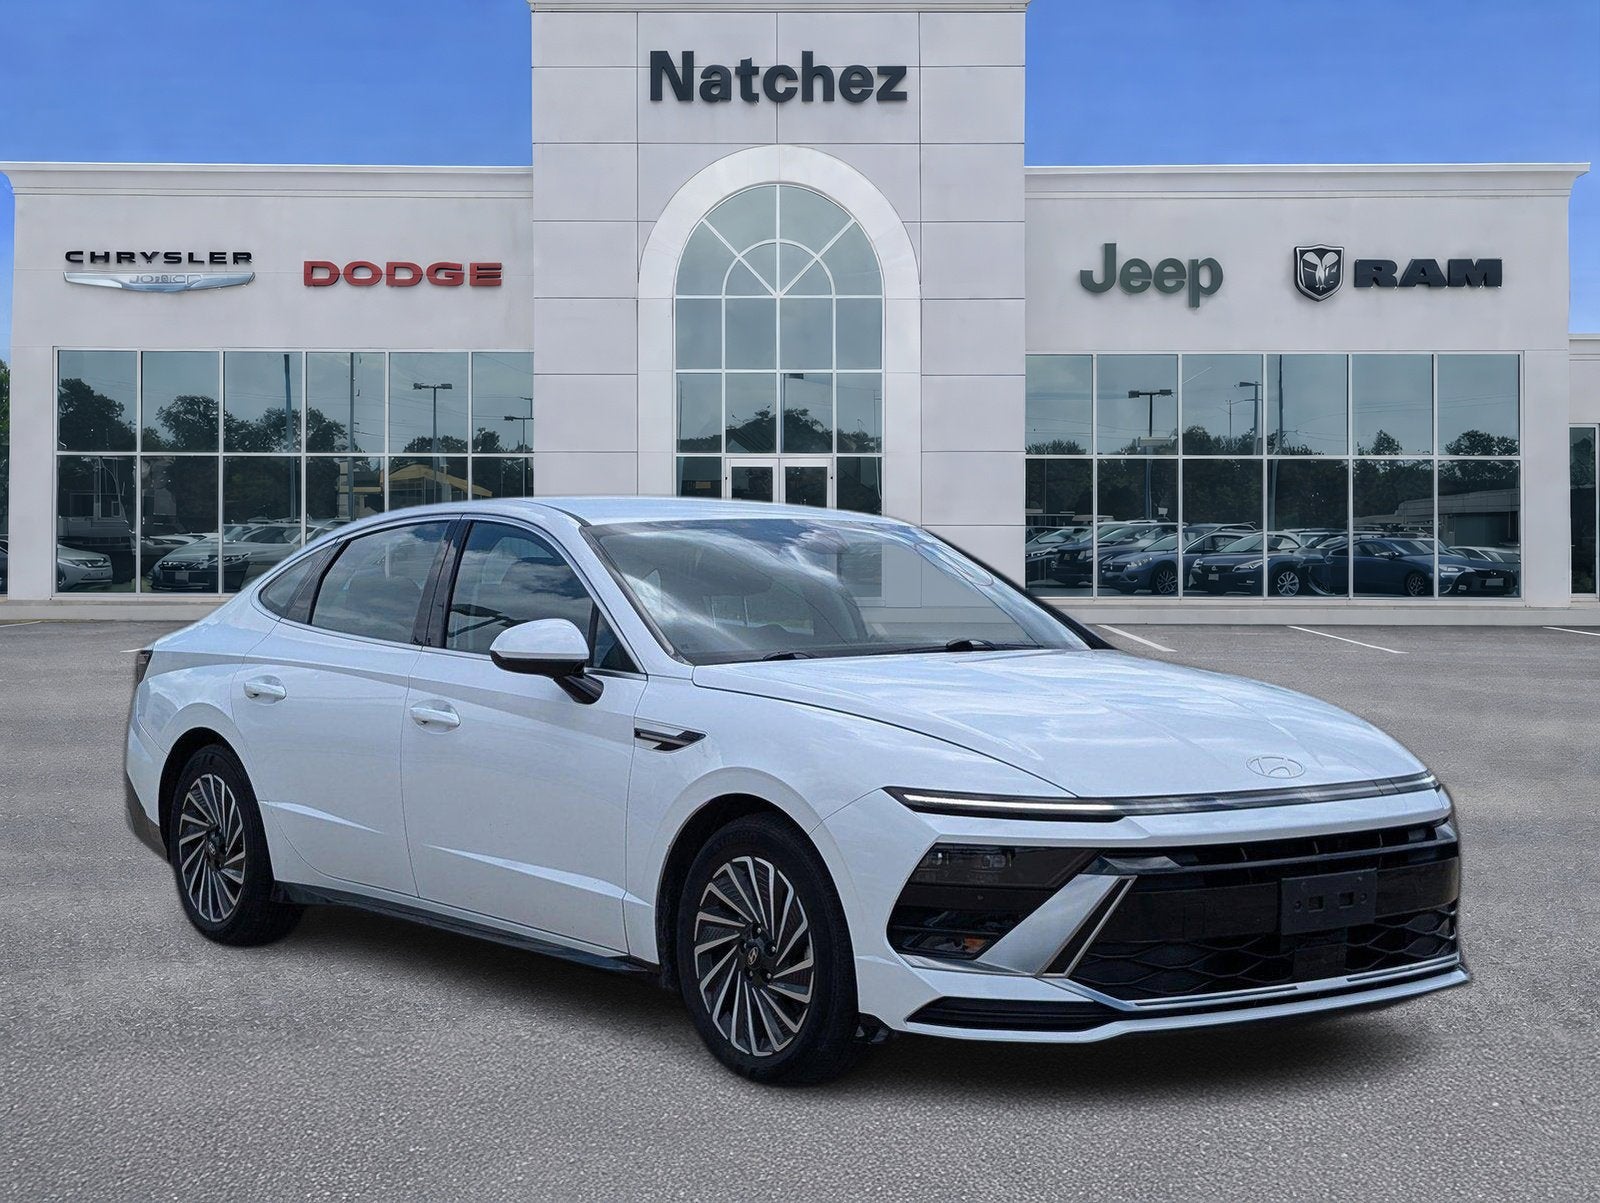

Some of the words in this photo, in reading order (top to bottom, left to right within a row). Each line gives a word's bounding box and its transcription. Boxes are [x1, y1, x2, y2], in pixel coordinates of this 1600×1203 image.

[650, 50, 908, 103] Natchez
[64, 250, 253, 265] CHRYSLER
[303, 261, 502, 287] DODGE
[1080, 242, 1224, 308] Jeep
[1354, 258, 1503, 288] RAM
